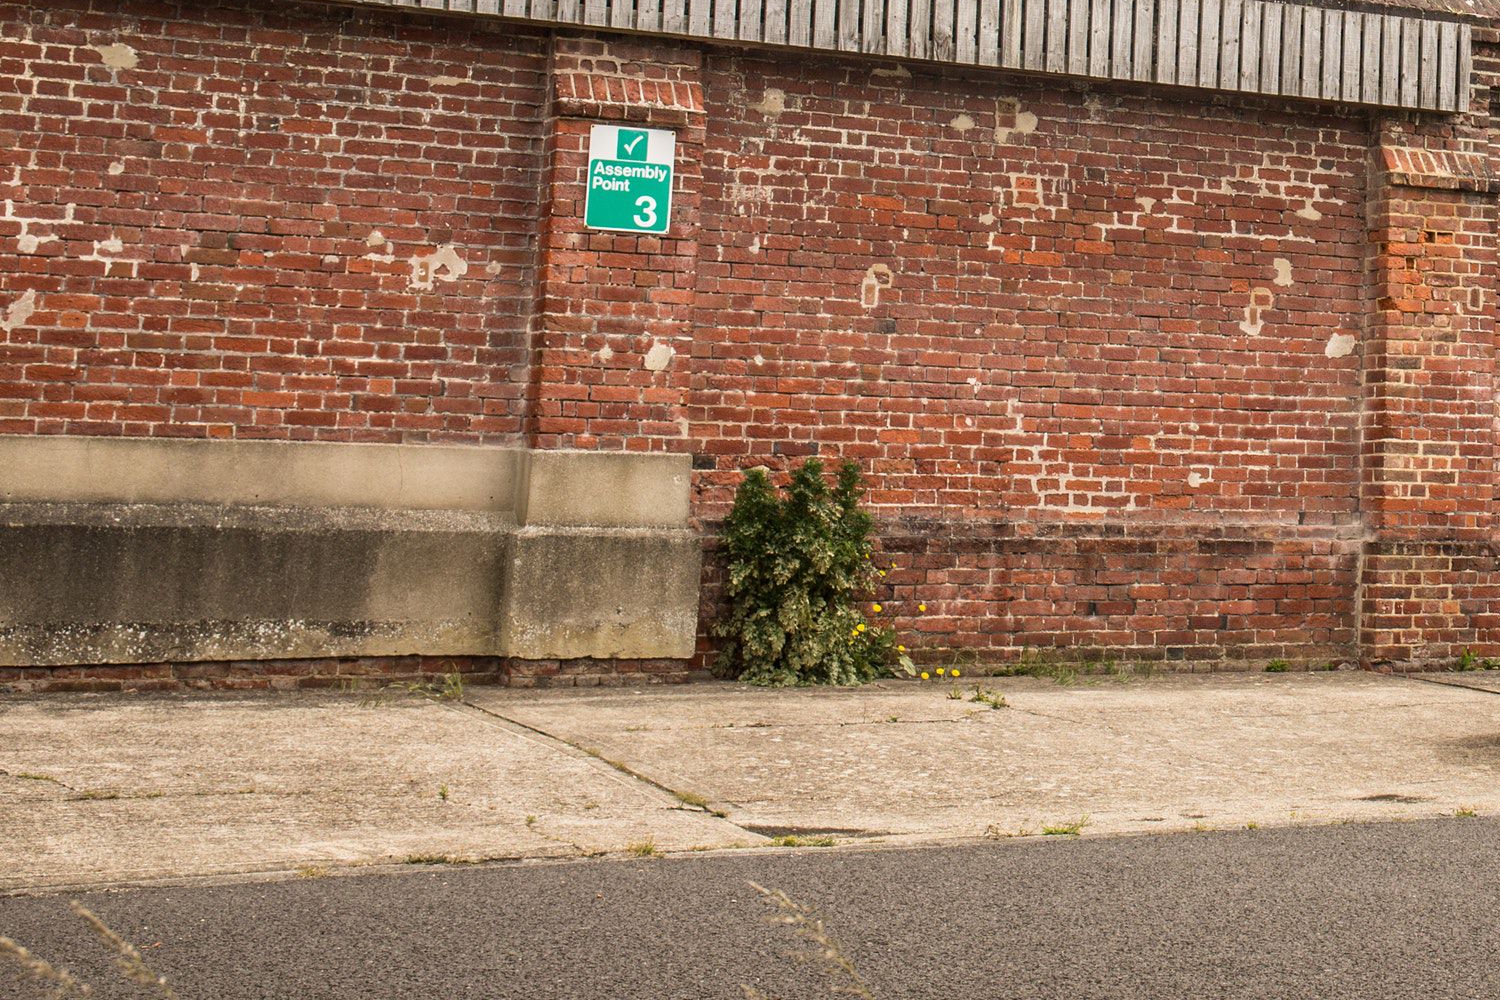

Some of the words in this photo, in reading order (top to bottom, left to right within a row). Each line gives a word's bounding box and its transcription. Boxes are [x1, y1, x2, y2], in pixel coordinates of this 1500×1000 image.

[594, 161, 668, 182] Assembly
[592, 176, 630, 192] Point
[633, 195, 657, 228] 3
